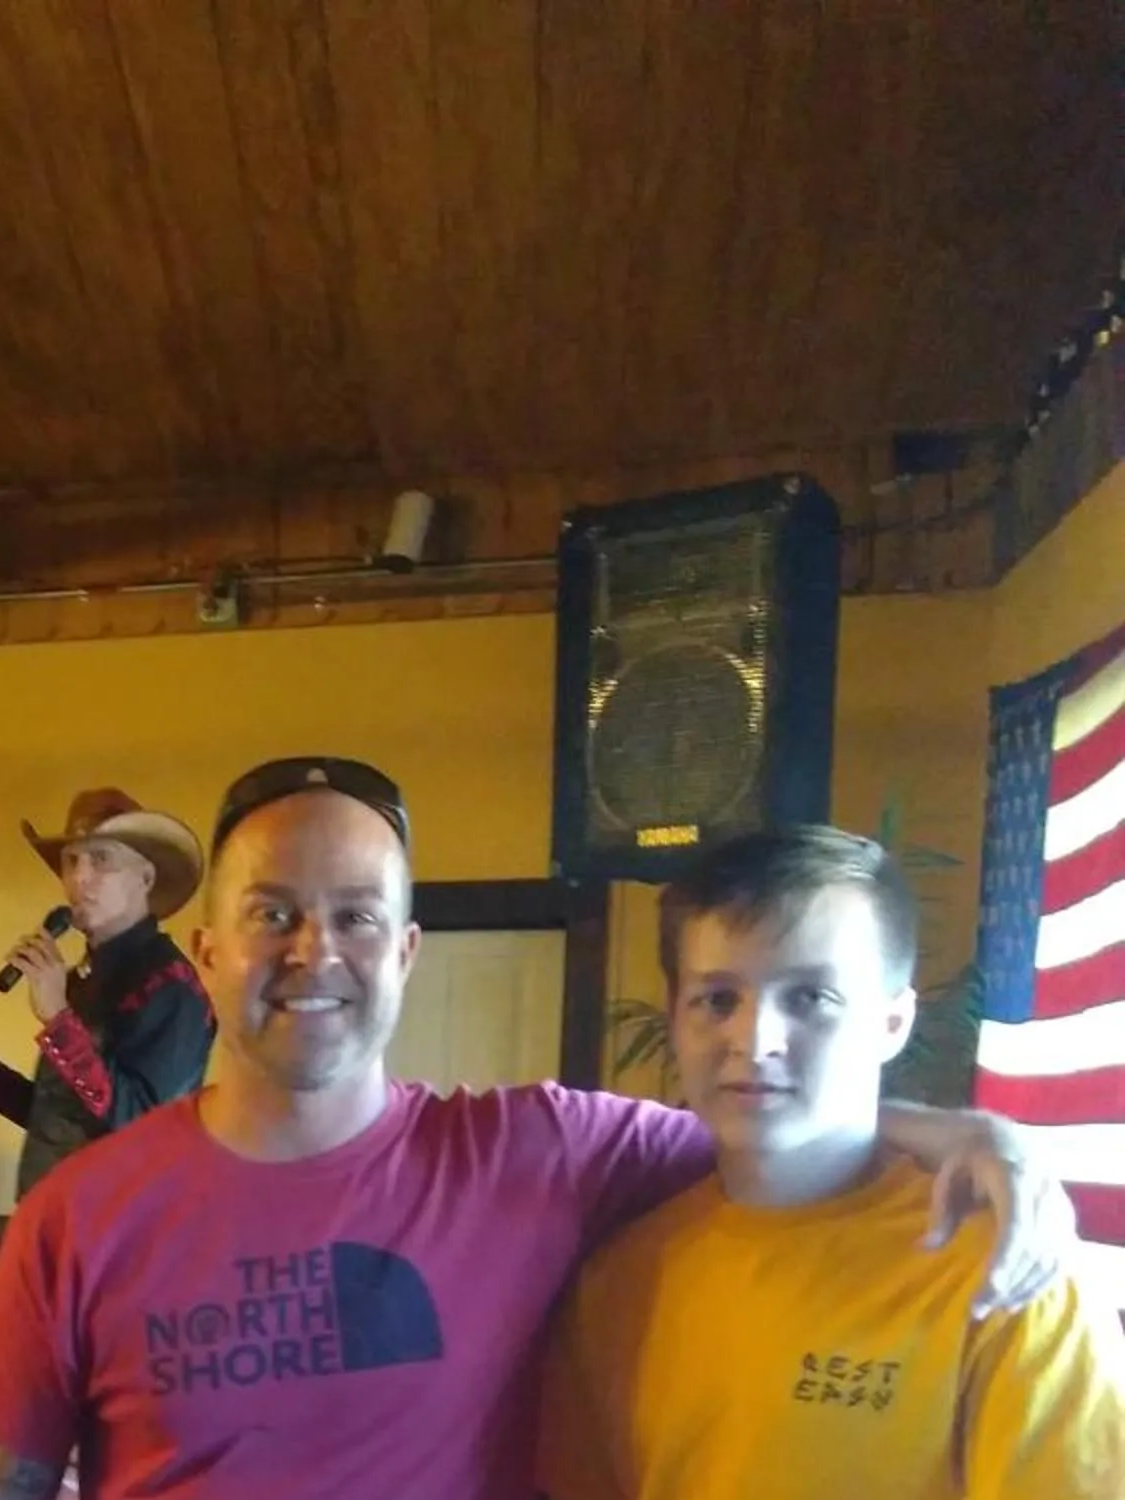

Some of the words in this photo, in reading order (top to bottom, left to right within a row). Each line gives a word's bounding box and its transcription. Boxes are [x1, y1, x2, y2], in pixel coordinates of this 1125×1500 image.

[234, 1249, 329, 1293] THE
[149, 1333, 341, 1395] SHORE
[803, 1352, 900, 1384] REST
[794, 1378, 894, 1411] EASY
